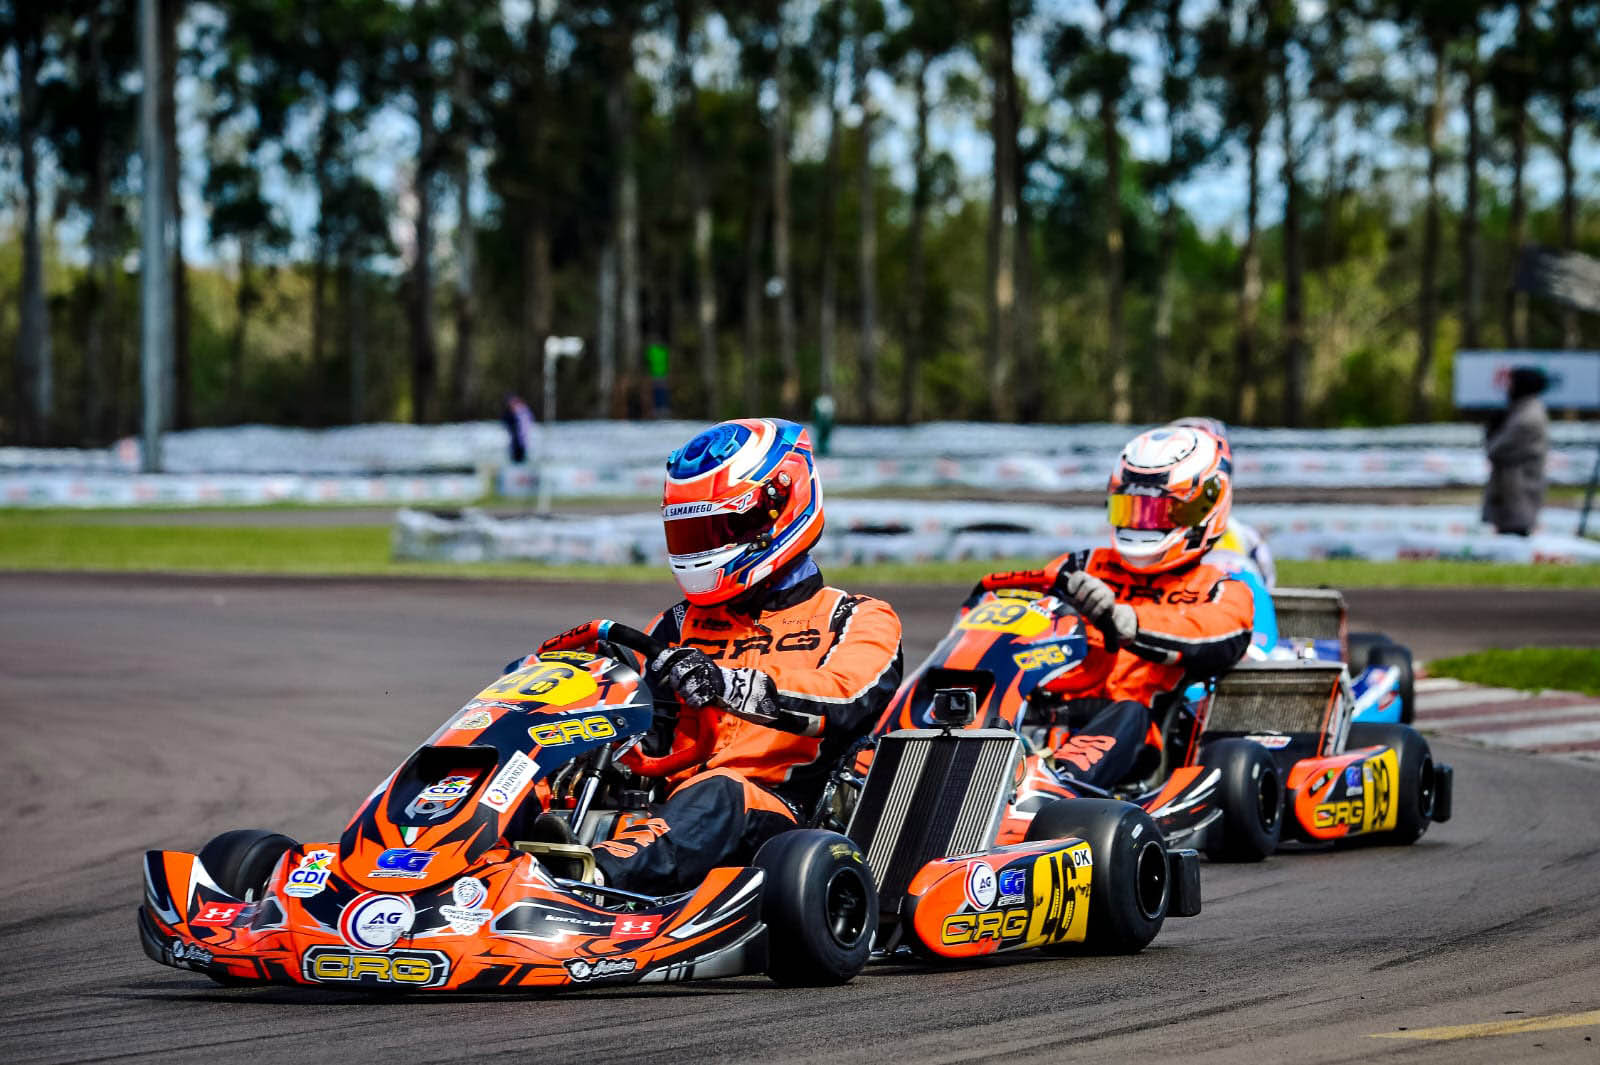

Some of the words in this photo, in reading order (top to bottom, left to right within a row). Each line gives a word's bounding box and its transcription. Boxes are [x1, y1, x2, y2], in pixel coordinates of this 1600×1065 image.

[670, 504, 712, 516] SAMANIEGO
[968, 604, 1028, 625] 69
[539, 651, 597, 661] CRG
[1013, 645, 1066, 671] CRG
[528, 716, 617, 747] CRG
[1313, 800, 1364, 829] CRG
[376, 848, 438, 873] GG
[1074, 850, 1090, 866] OK
[291, 870, 327, 885] CDI
[980, 876, 992, 889] AG
[368, 912, 403, 924] AG
[942, 908, 1028, 945] CRG
[315, 955, 432, 983] CRG
